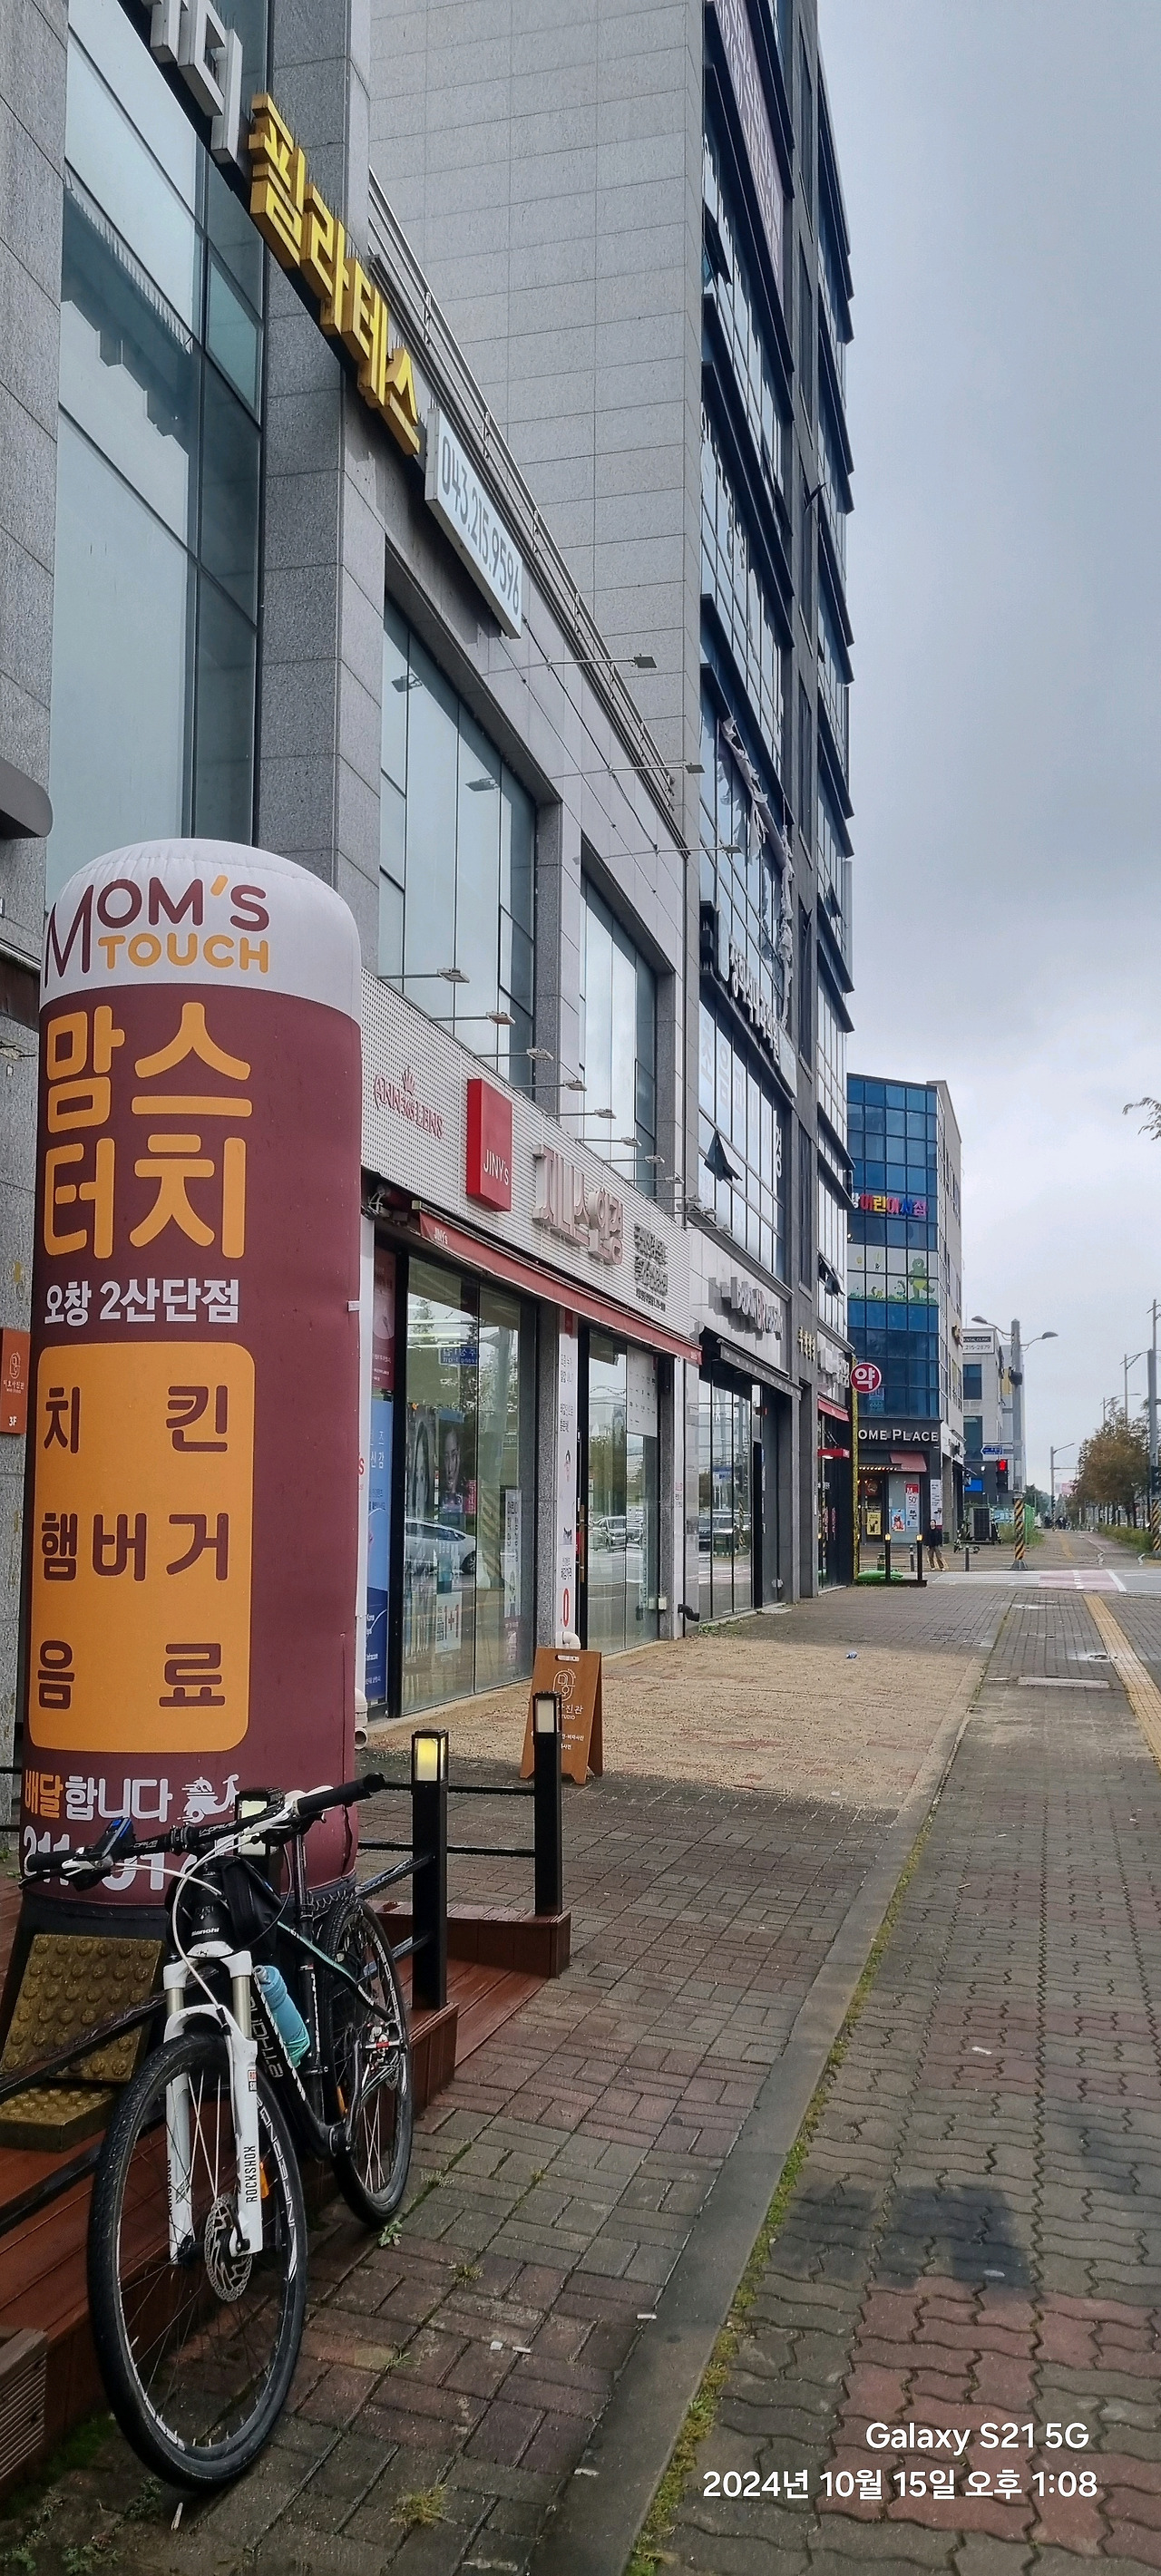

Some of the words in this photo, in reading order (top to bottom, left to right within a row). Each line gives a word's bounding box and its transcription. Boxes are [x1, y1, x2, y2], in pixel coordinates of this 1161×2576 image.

[249, 93, 420, 455] 필라테스
[442, 435, 520, 617] 043.215.9596
[44, 872, 271, 988] MOM'S
[97, 933, 270, 974] TOUCH
[45, 1001, 253, 1133] 맘스
[43, 1133, 248, 1259] 터치
[44, 1283, 93, 1326] 오창
[99, 1277, 239, 1325] 2산단점
[854, 1367, 875, 1390] 약
[9, 1415, 17, 1427] 3F
[858, 1429, 887, 1440] OME
[893, 1429, 939, 1442] PLACE
[41, 1512, 229, 1581] 햄버거
[24, 1768, 173, 1823] 배달합니다
[190, 1927, 220, 1937] Bianchi
[244, 2145, 258, 2203] ROCKSHOX
